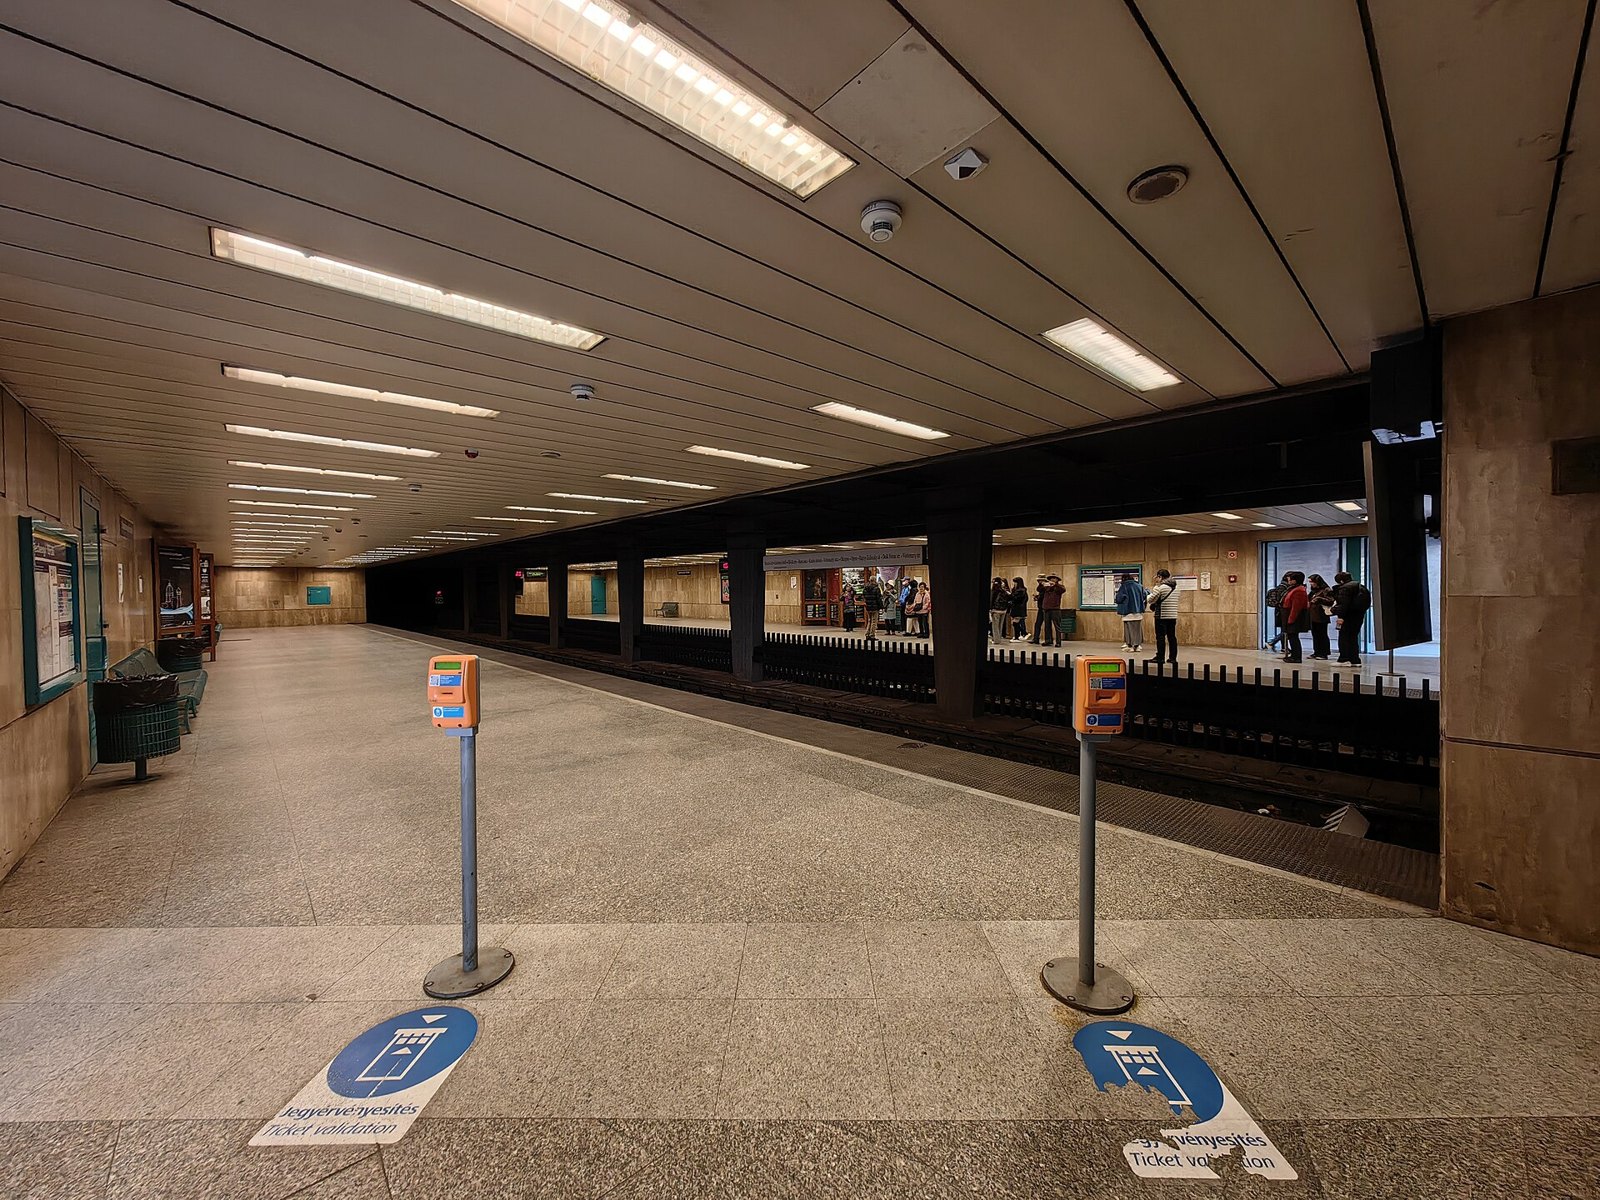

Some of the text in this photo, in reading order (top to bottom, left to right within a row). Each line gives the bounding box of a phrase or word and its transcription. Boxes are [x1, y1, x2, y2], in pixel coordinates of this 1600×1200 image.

[279, 1103, 420, 1121] Jegyérvényesítés
[262, 1121, 398, 1137] Ticket validation
[1130, 1152, 1276, 1169] Ticket vation
